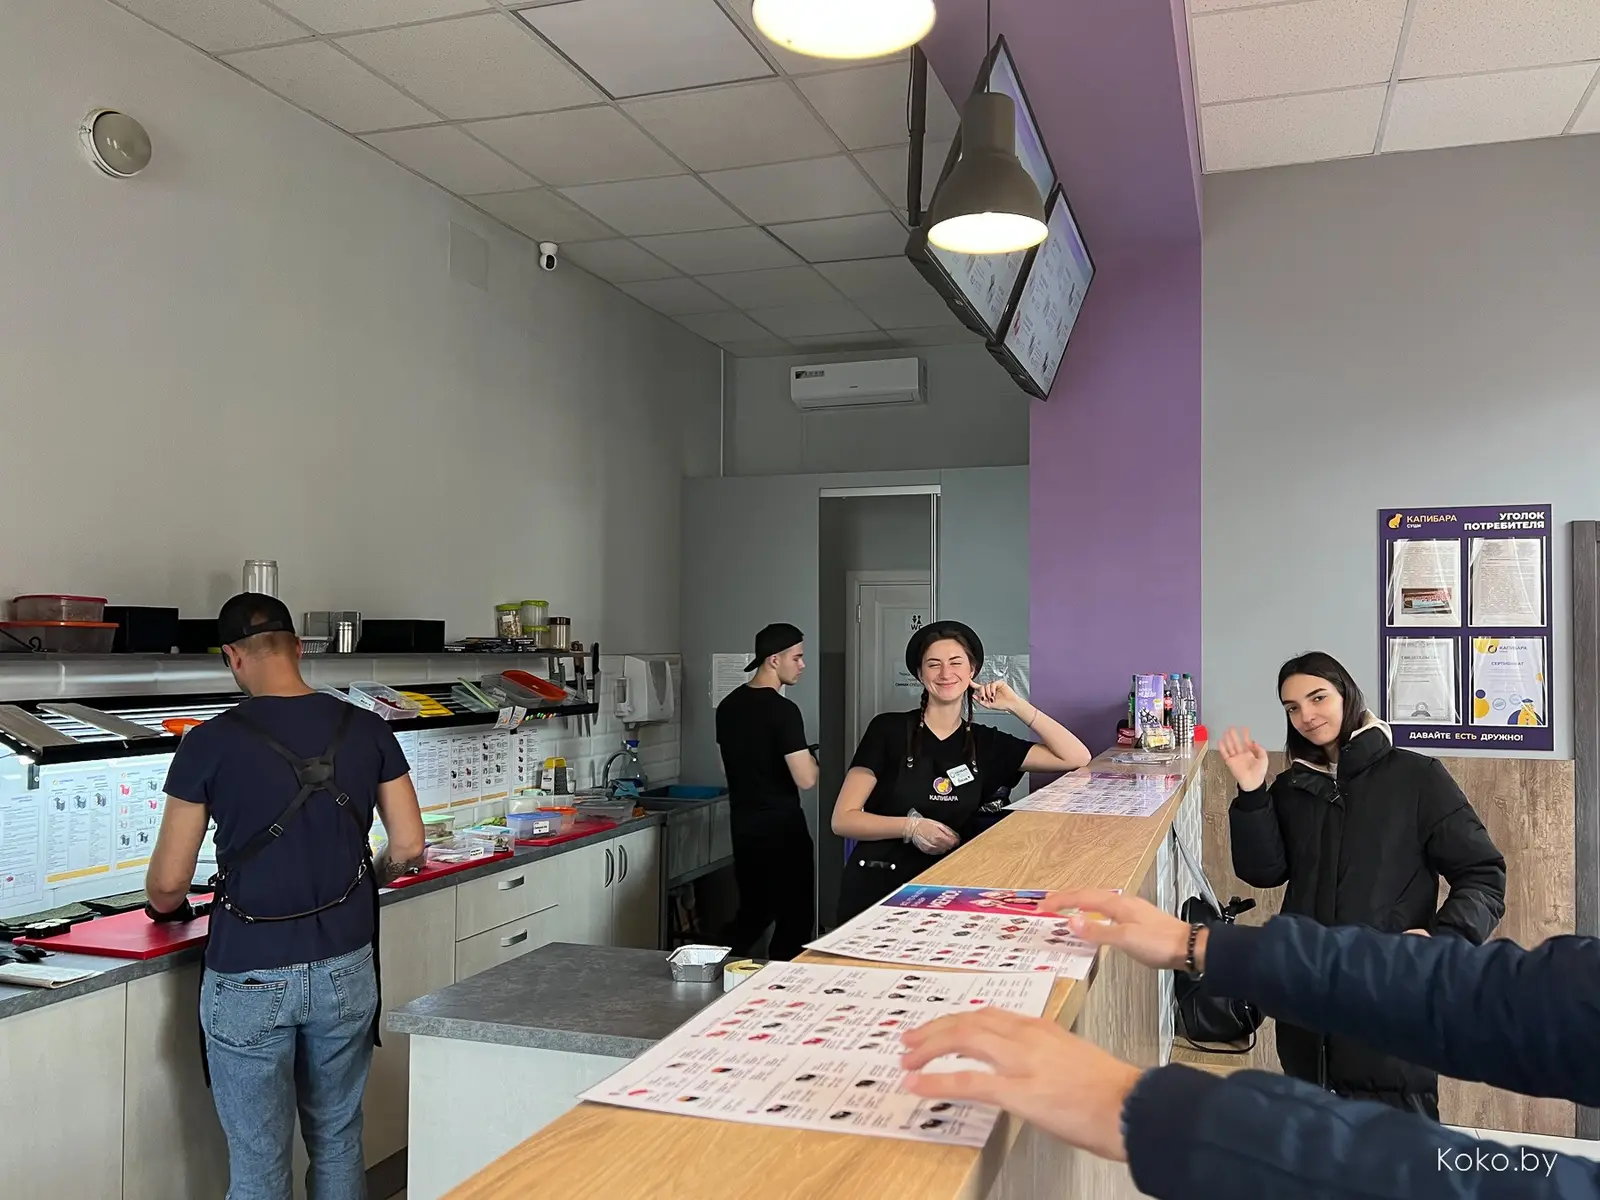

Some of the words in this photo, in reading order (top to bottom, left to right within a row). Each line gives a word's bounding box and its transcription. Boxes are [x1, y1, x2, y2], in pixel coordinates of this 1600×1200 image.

[1406, 514, 1457, 523] КАПИБАРА
[1499, 511, 1545, 521] УГОЛОК
[1463, 520, 1545, 531] ПОТРЕБИТЕЛЯ
[1409, 731, 1451, 740] ДАВАЙТЕ
[1455, 732, 1477, 740] ЕСТЬ
[1480, 733, 1524, 741] ДРУЖНО!
